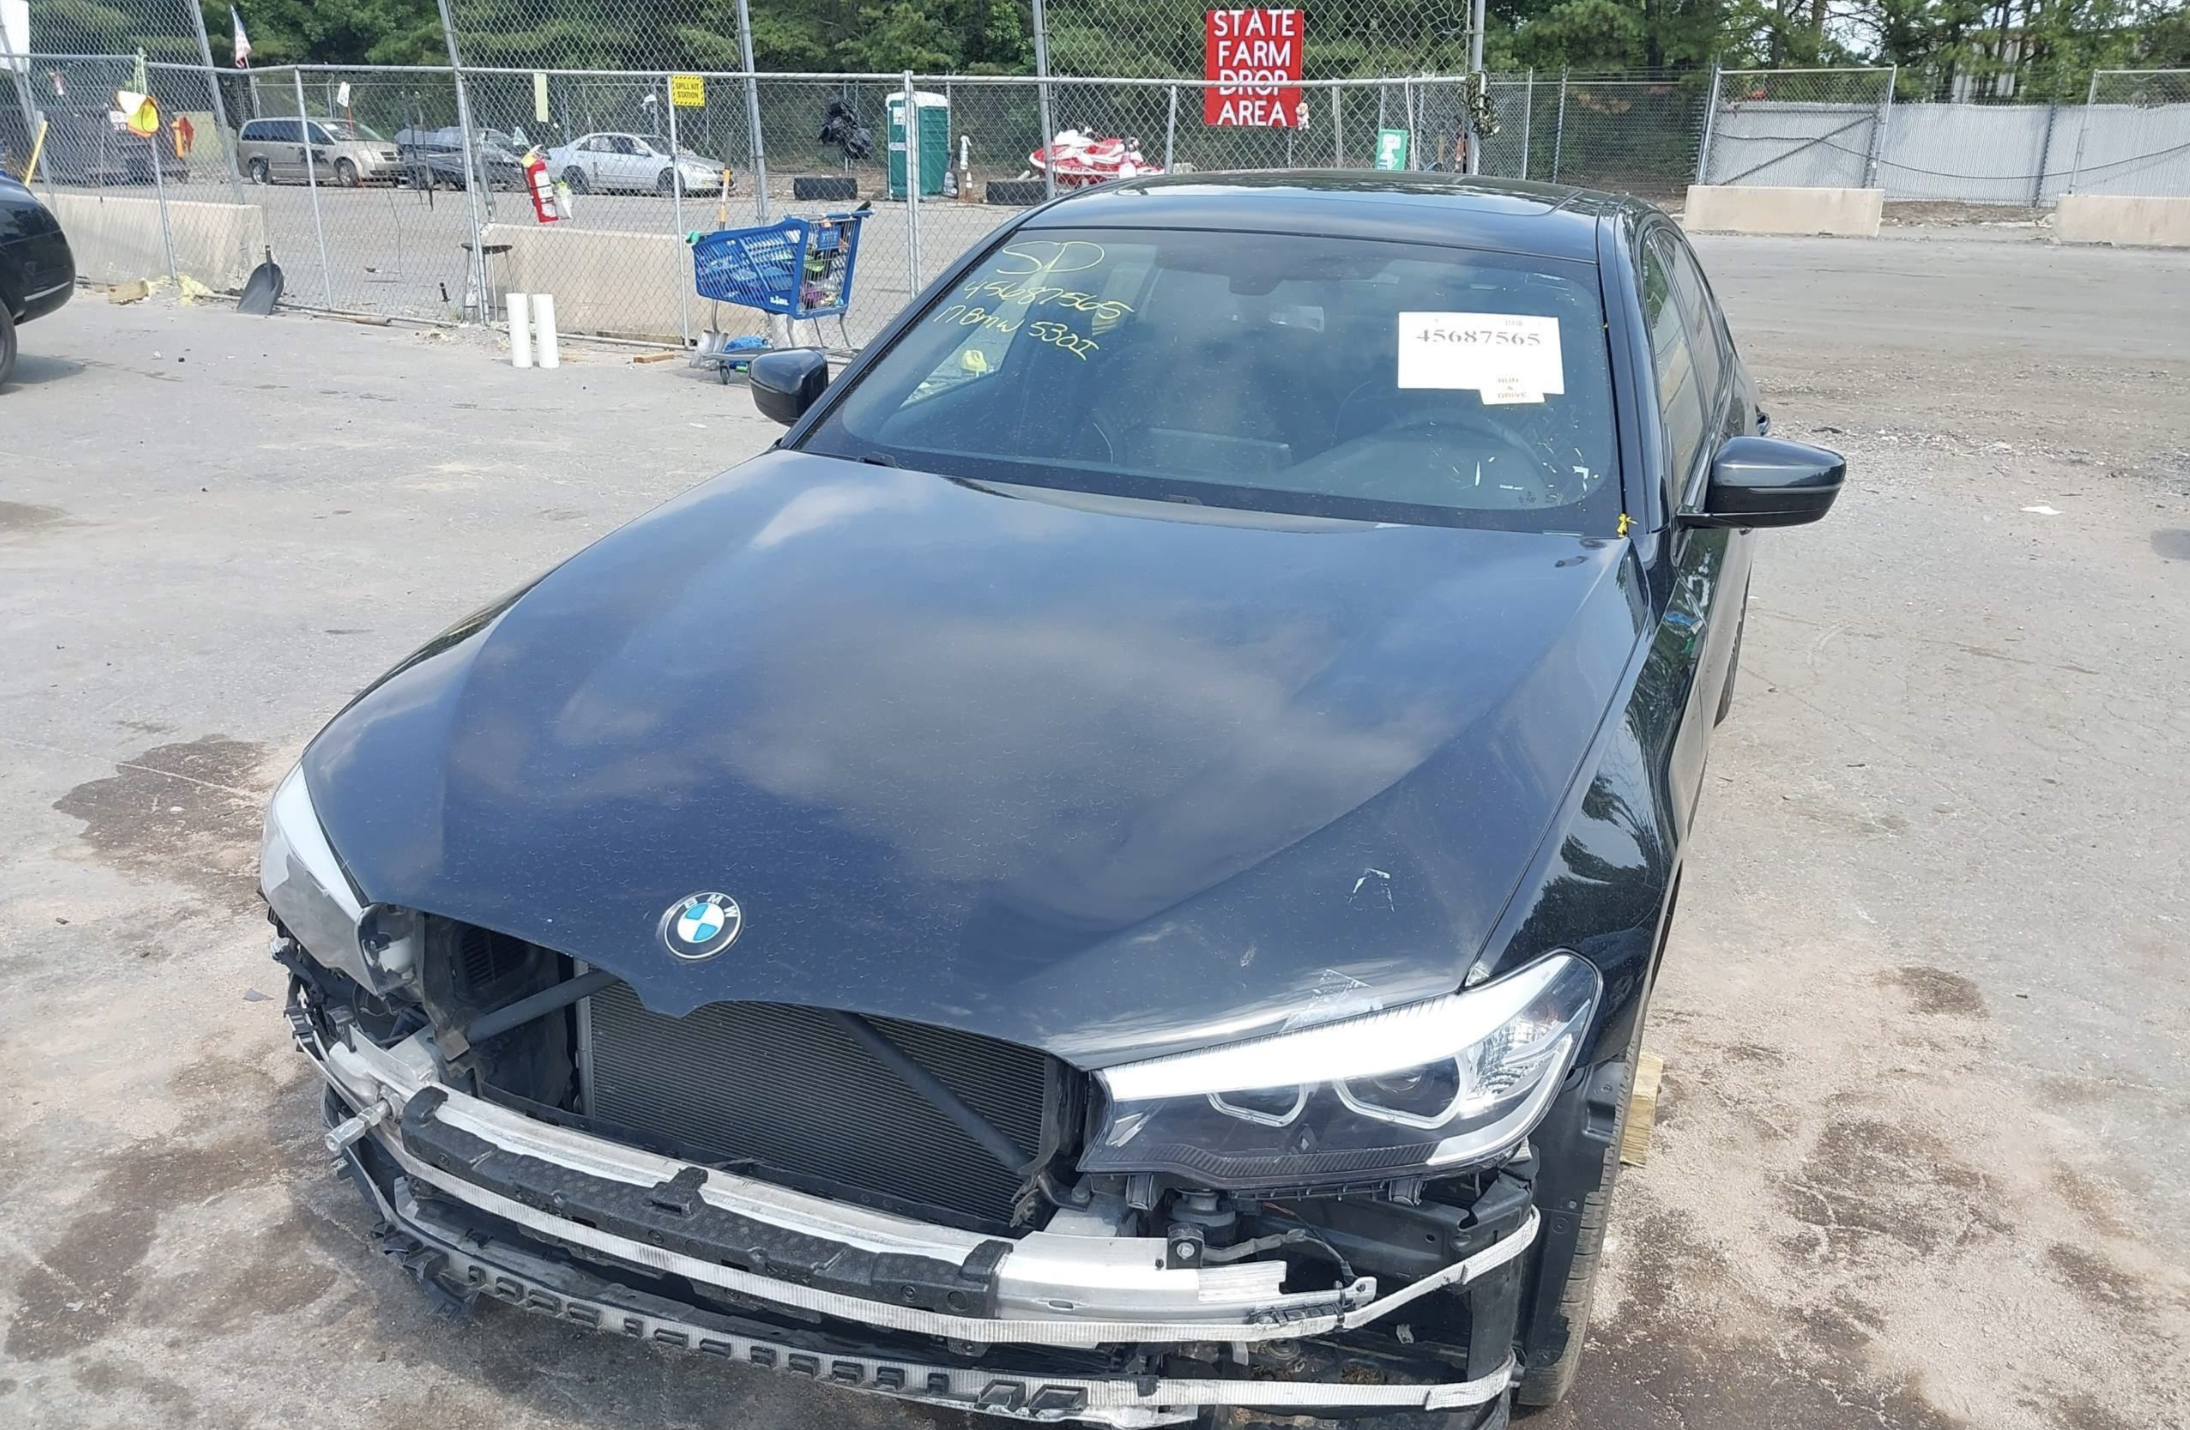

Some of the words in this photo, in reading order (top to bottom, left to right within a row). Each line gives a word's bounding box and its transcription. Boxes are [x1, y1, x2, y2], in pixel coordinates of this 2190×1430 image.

[1213, 9, 1295, 37] STATE
[1218, 40, 1291, 67] FARM
[675, 82, 690, 90] SPILL
[1219, 69, 1288, 96] DROP
[1217, 100, 1288, 127] AREA
[997, 240, 1105, 274] SD
[964, 279, 1135, 321] 45687565
[1416, 328, 1542, 347] 45687565
[683, 893, 738, 918] BMW
